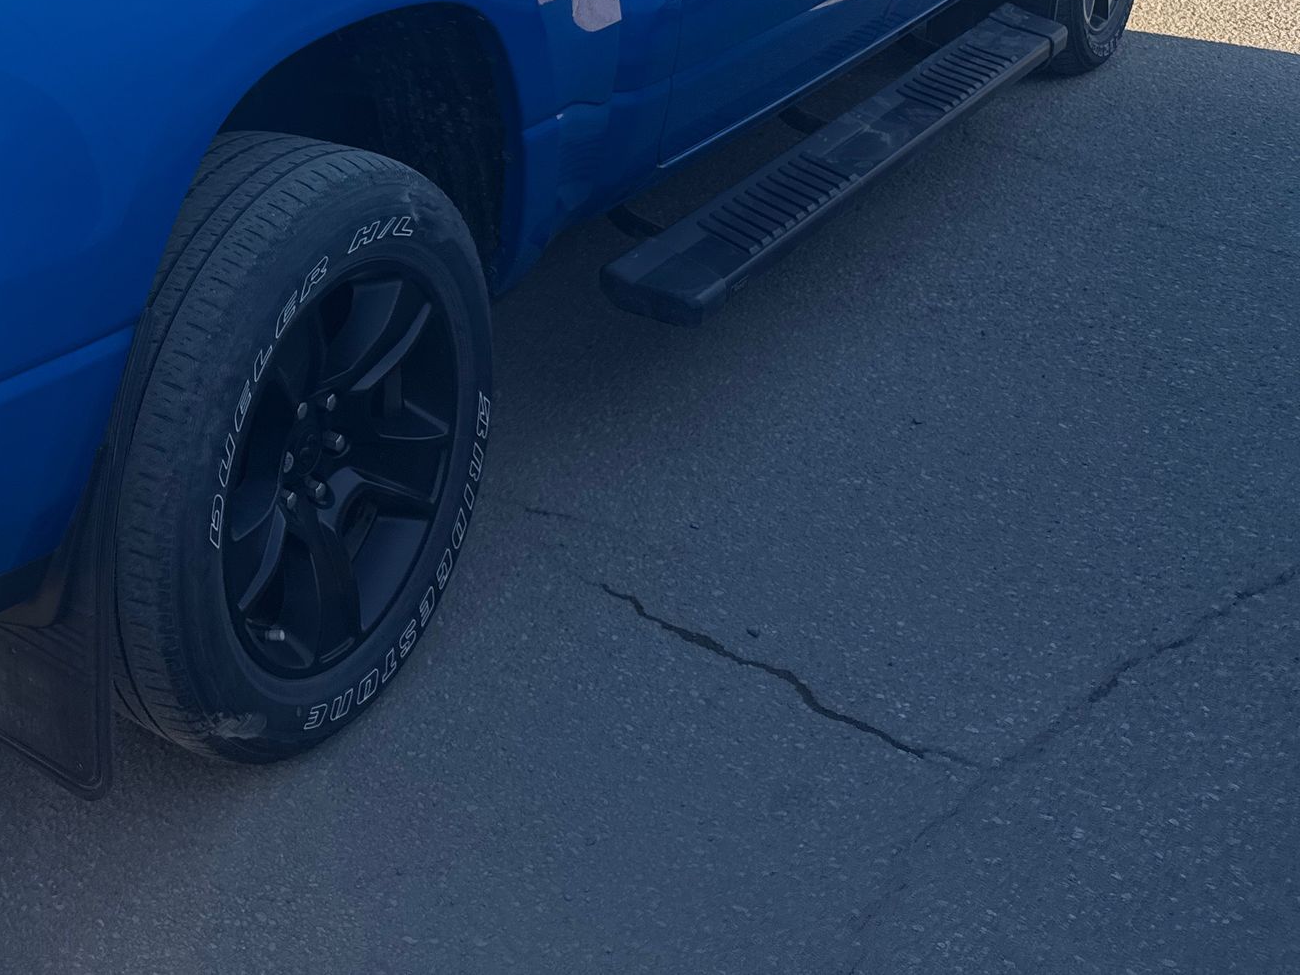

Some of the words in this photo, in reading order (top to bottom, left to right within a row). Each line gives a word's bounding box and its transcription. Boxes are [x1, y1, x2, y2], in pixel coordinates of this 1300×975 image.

[209, 256, 329, 549] DUELER
[348, 216, 413, 254] H/L
[303, 390, 492, 731] BRIDGESTONE
